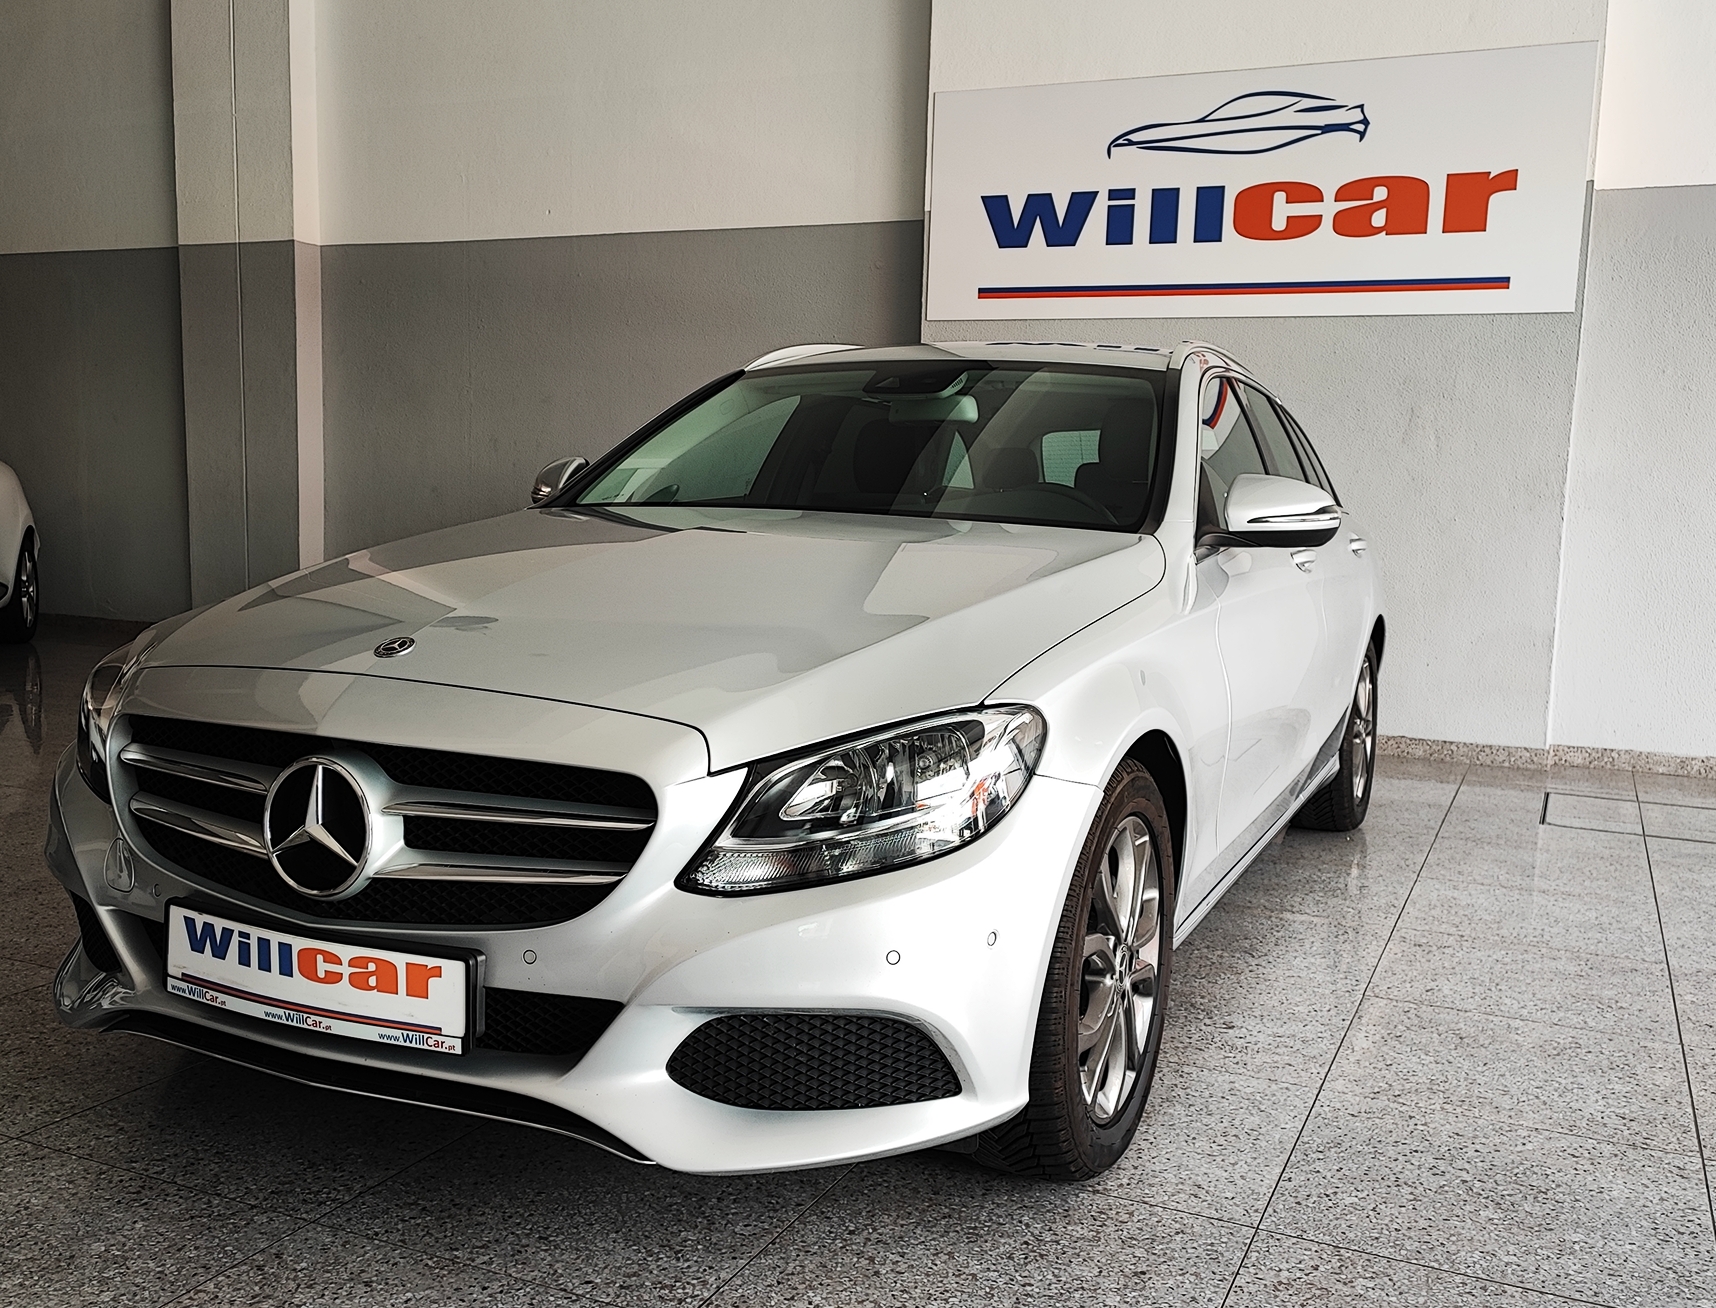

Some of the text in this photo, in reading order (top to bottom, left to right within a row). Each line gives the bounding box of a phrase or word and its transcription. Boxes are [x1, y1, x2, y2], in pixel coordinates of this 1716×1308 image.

[170, 983, 227, 1007] www.WillCar.pt
[263, 1010, 332, 1032] www.WillCar.pt
[377, 1031, 456, 1051] www.WillCar.pt
